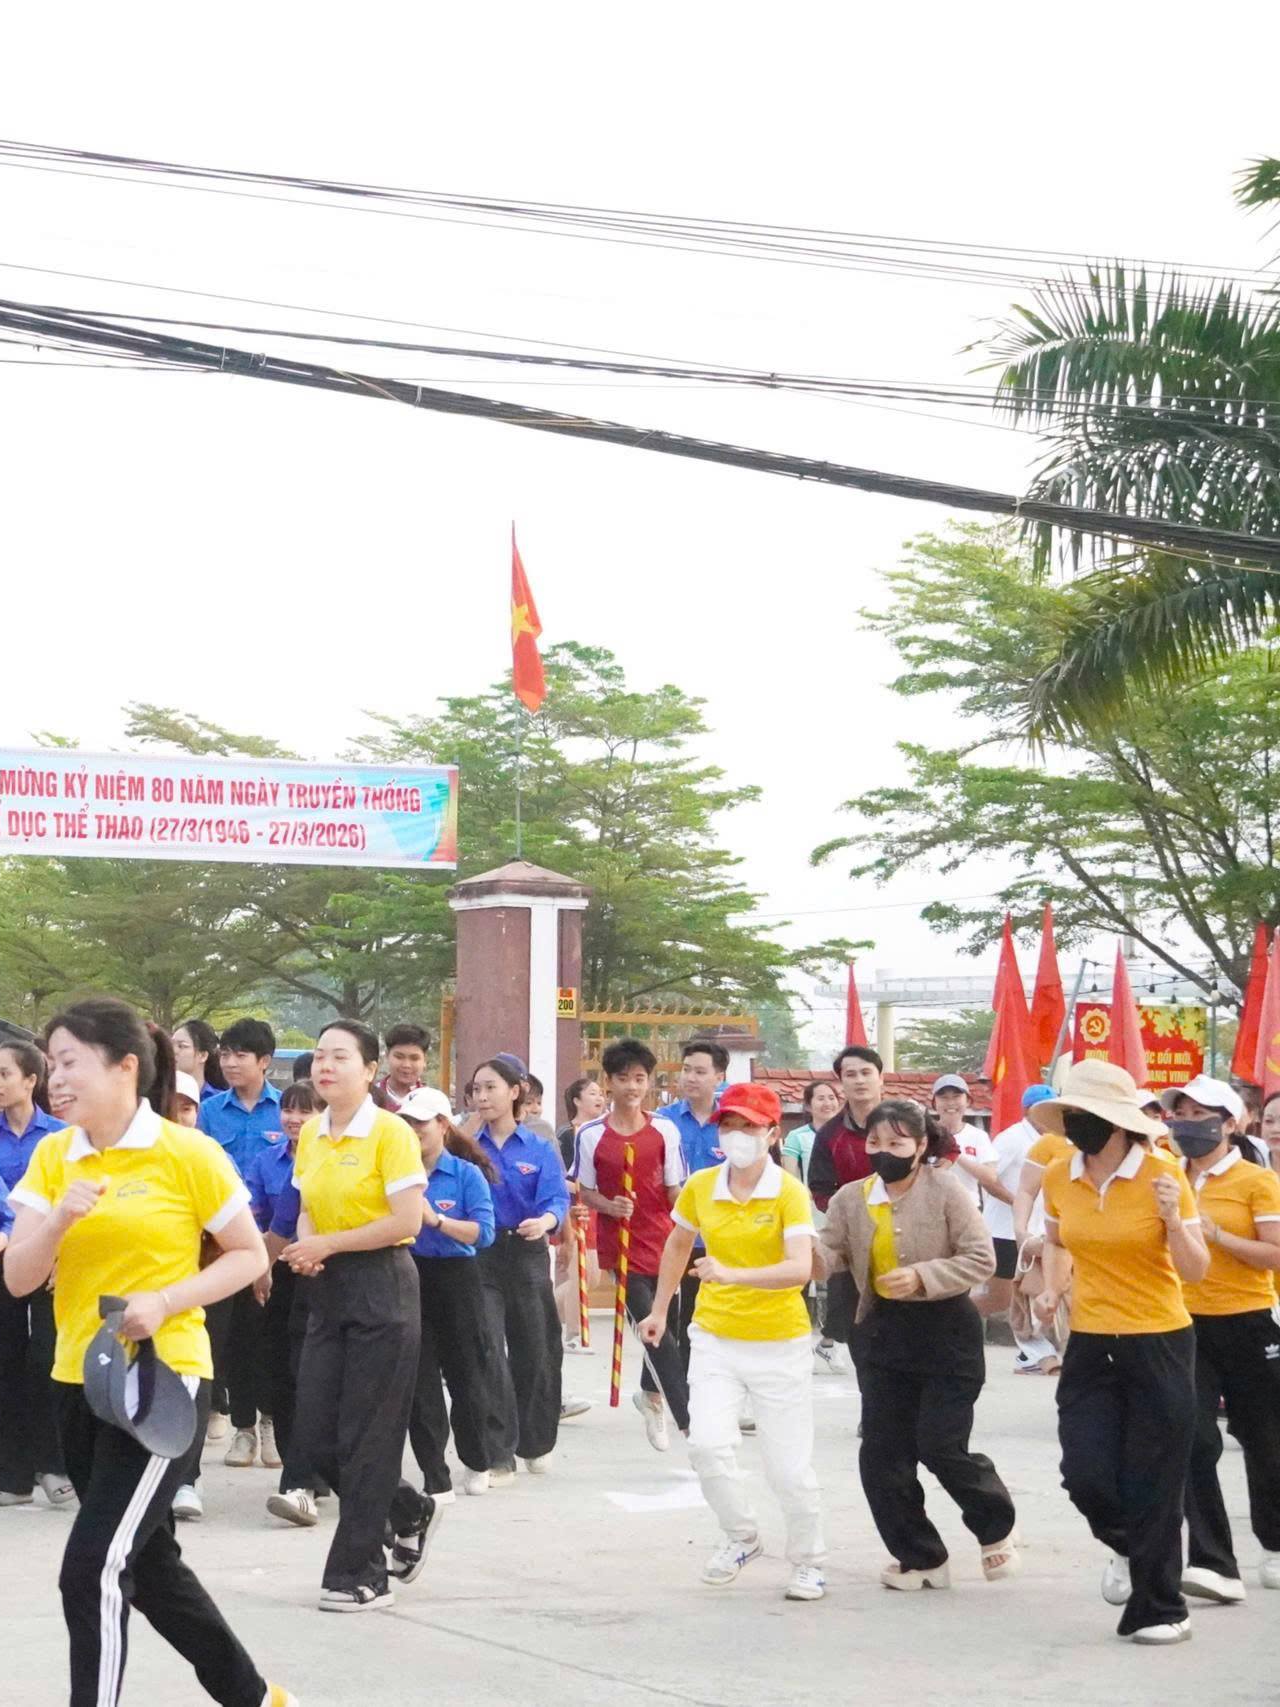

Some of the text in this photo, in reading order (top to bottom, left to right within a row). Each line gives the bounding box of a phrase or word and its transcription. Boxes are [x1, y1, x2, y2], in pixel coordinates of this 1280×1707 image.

[64, 764, 89, 799] KỶ
[95, 769, 145, 807] NIỆM
[152, 777, 174, 803] 80
[180, 775, 224, 805] NĂM
[230, 777, 280, 807] NGÀY
[286, 777, 355, 811] TRUYỀN
[361, 778, 421, 813] THỐNG
[8, 809, 47, 842] DỤC
[53, 802, 90, 839] THỂ
[95, 813, 143, 841] THAO
[150, 816, 250, 845] (27/3/1946
[269, 821, 367, 851] 27/3/2026)
[558, 999, 574, 1010] 200
